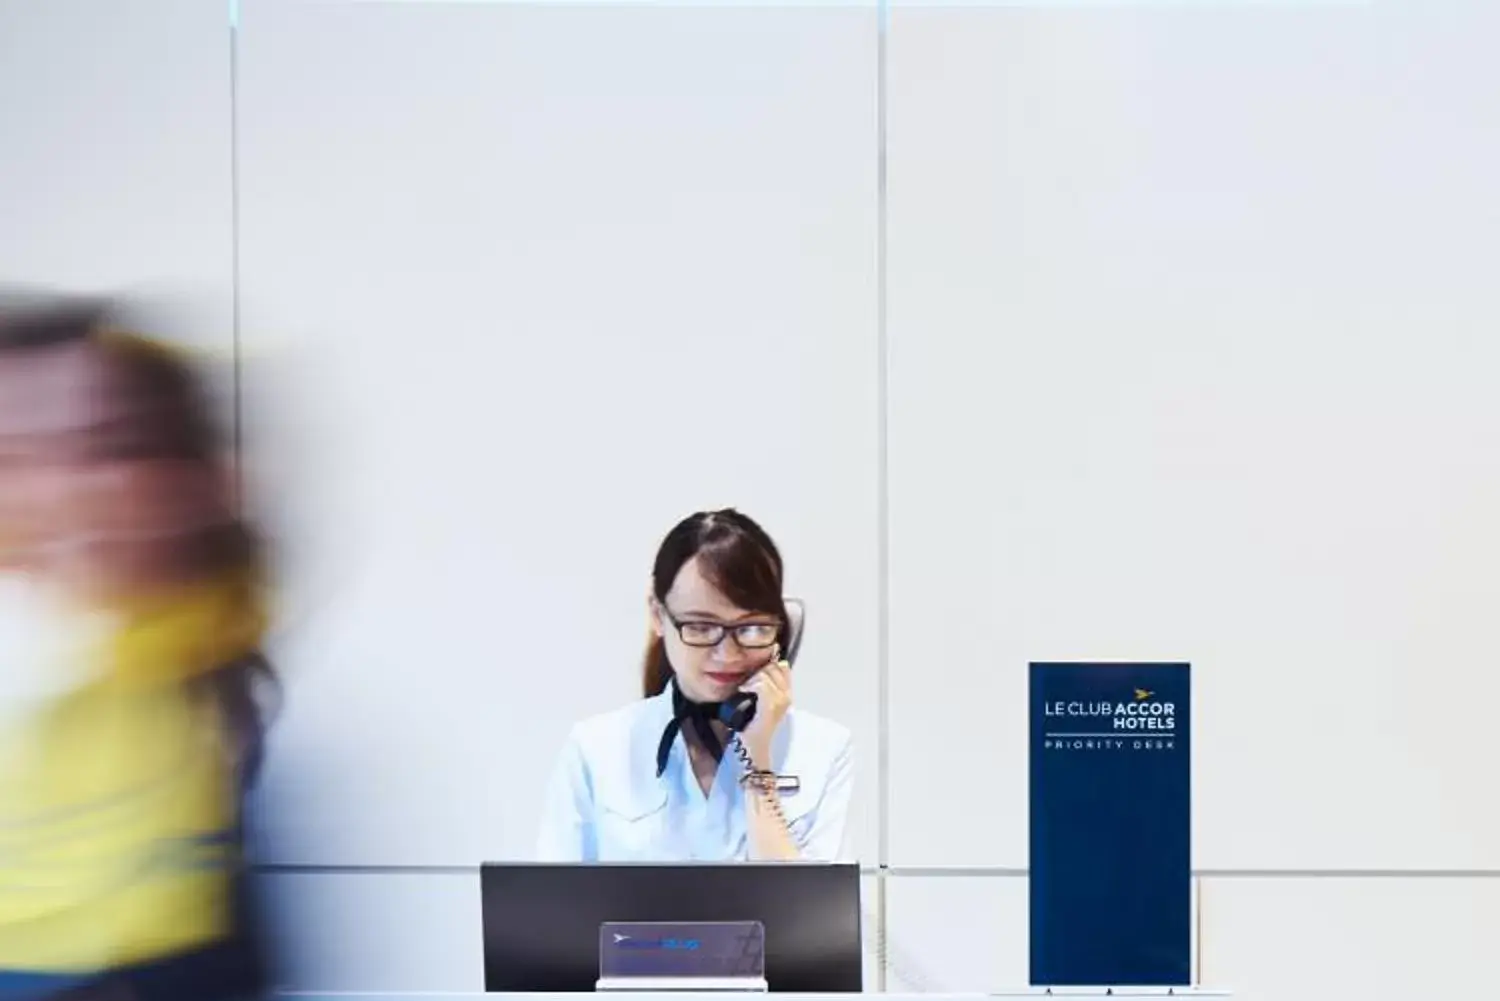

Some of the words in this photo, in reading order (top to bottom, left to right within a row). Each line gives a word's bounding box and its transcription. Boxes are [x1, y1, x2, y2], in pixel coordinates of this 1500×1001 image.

[1045, 702, 1065, 715] LE
[1068, 702, 1112, 715] CLUB
[1114, 703, 1175, 715] ACCOR
[1113, 718, 1175, 729] HOTELS
[1044, 740, 1123, 749] PRIORITY
[1133, 740, 1175, 749] DESK
